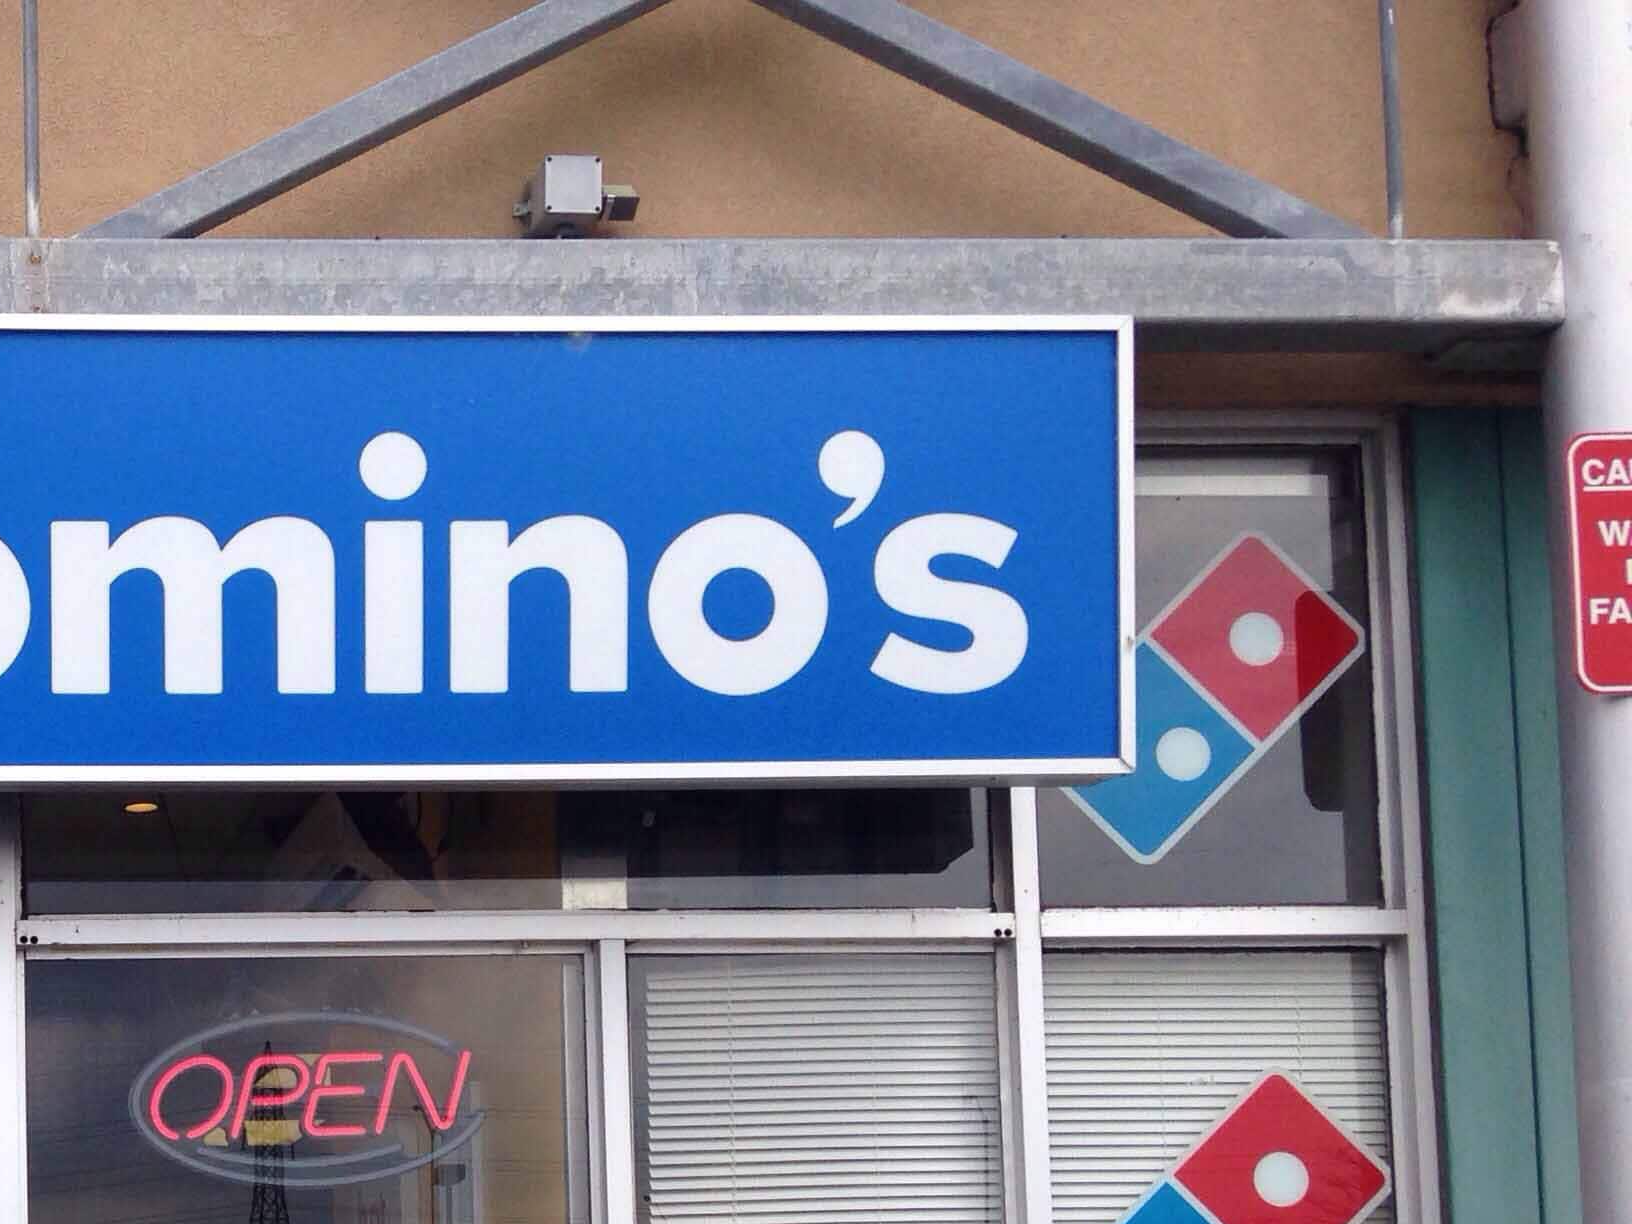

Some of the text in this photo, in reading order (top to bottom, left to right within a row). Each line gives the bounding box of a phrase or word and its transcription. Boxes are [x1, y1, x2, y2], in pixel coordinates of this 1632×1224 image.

[1581, 458, 1632, 487] CA
[1597, 520, 1632, 547] W
[150, 1050, 472, 1140] OPEN
